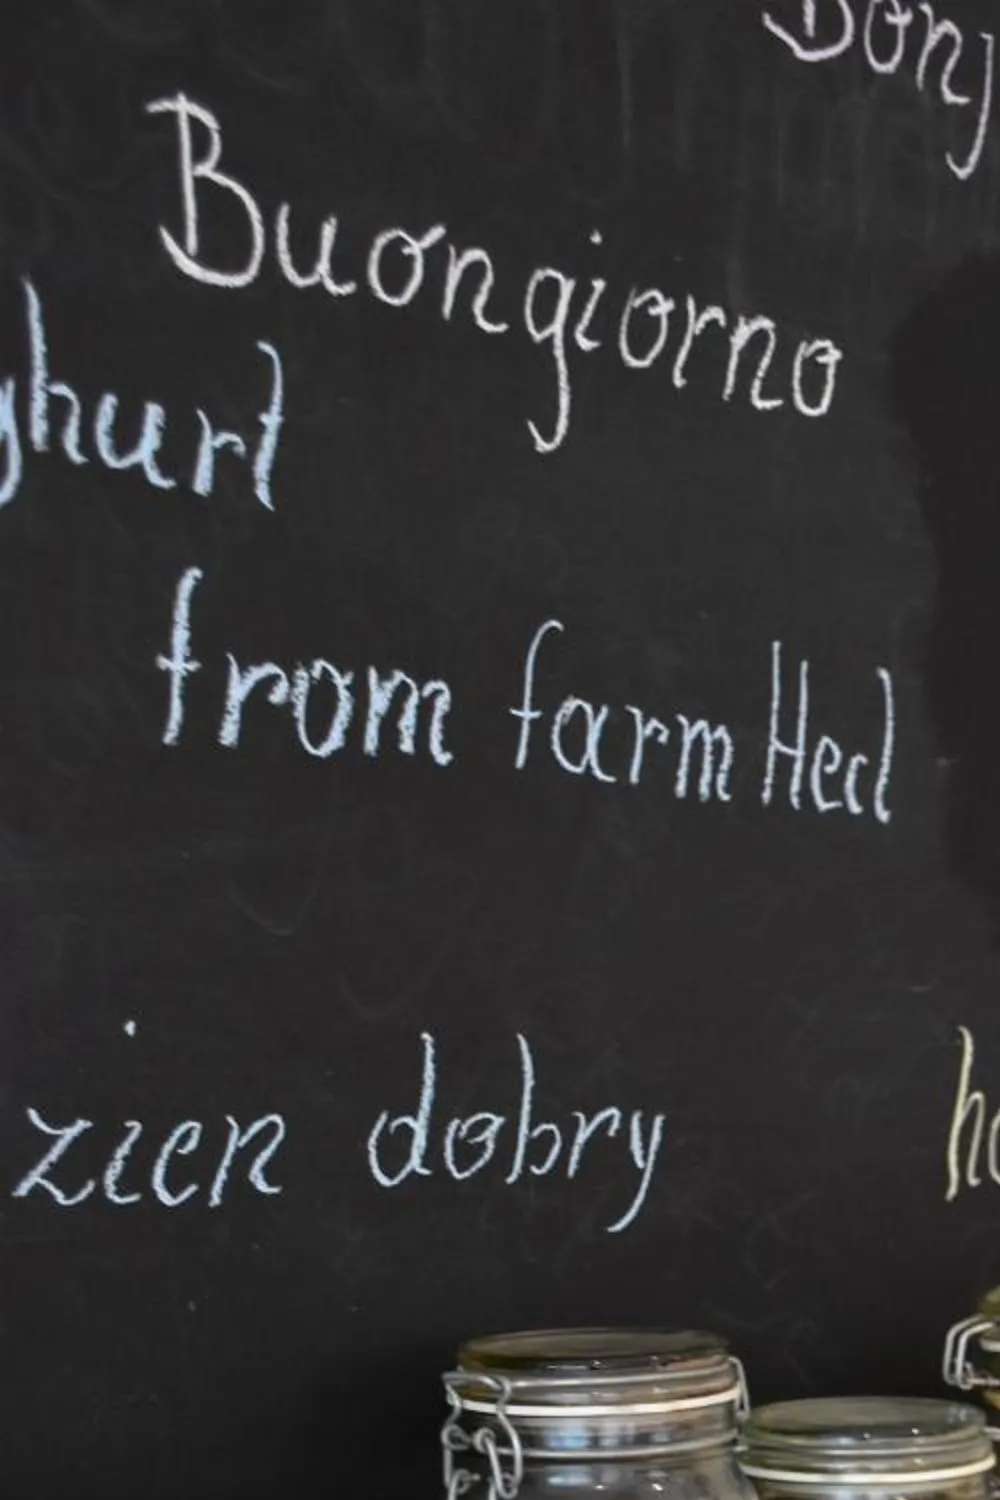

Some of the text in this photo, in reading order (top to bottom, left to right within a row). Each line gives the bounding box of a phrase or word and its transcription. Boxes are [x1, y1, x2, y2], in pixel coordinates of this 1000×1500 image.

[146, 93, 842, 452] Buongiorno
[157, 568, 453, 766] from
[509, 620, 733, 802] farm
[368, 1032, 665, 1233] dobry
